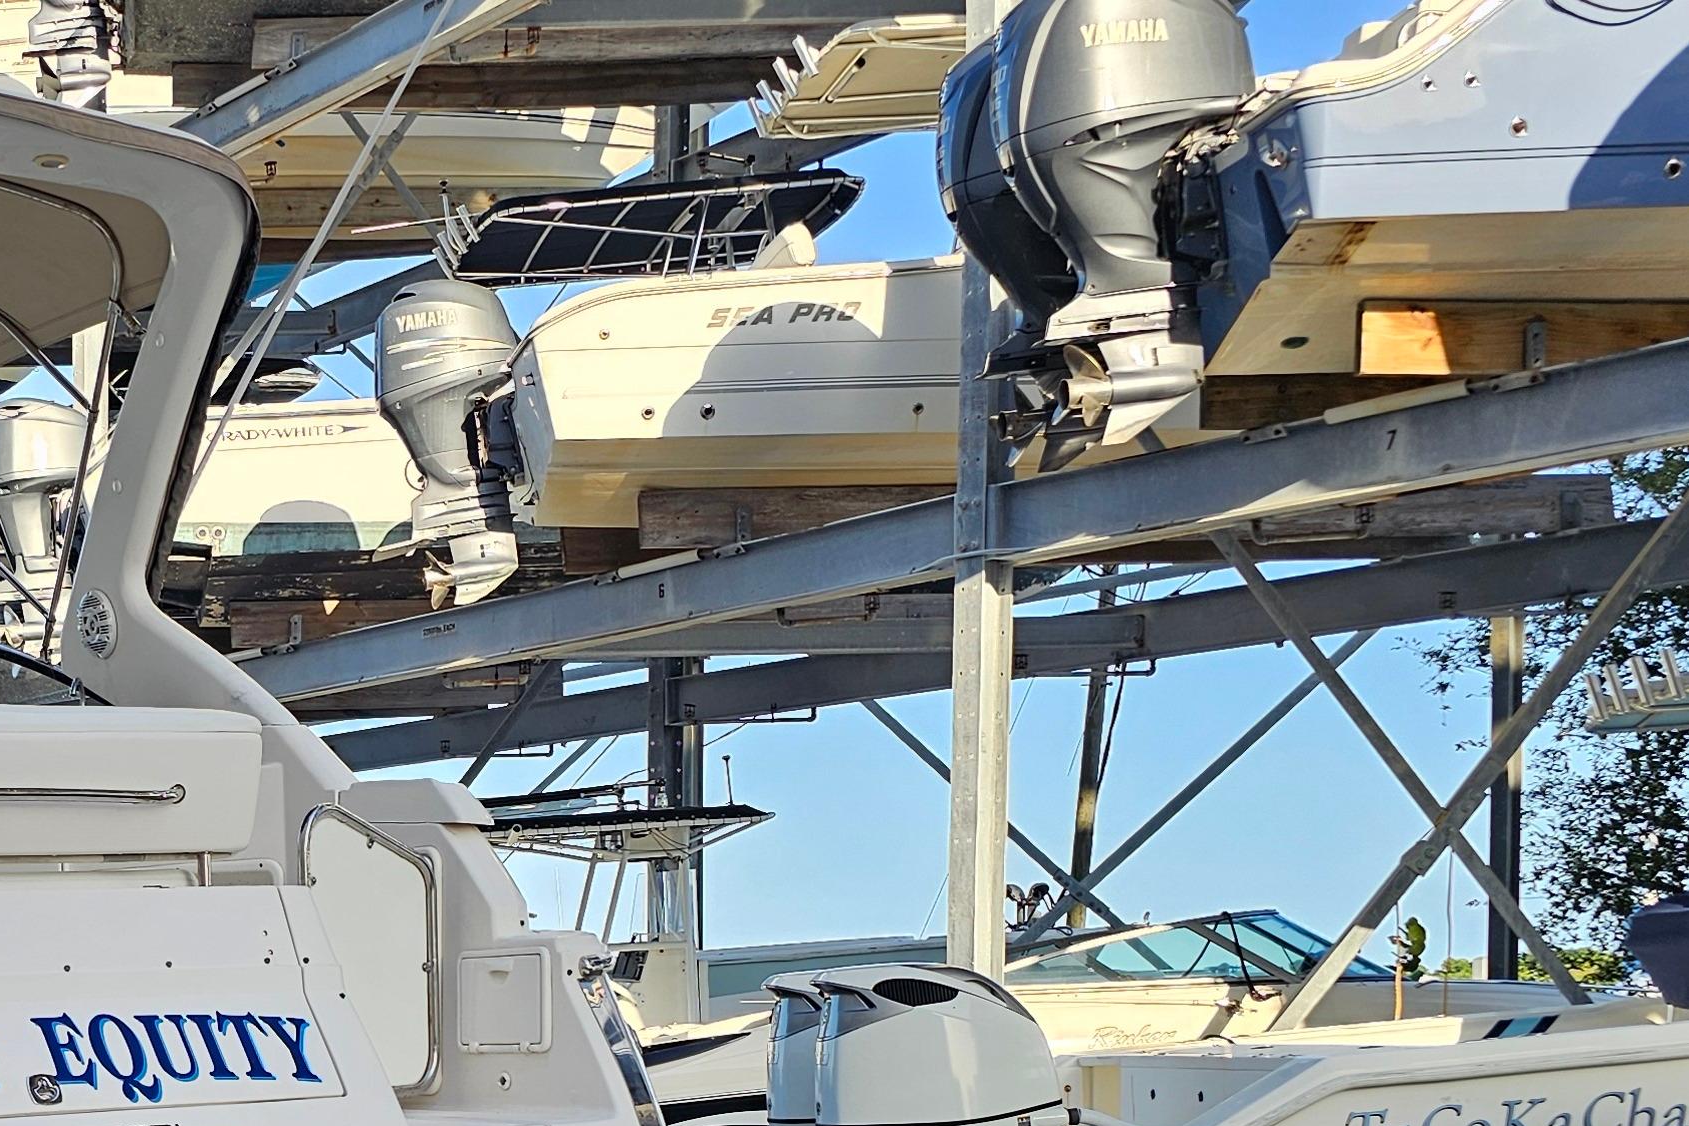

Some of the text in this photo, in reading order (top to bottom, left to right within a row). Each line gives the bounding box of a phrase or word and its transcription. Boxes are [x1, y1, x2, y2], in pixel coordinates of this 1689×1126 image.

[1079, 17, 1169, 48] YAMAHA
[395, 310, 458, 334] YAMAHA
[706, 302, 862, 328] SEA PRO
[1386, 429, 1398, 451] 7
[658, 583, 665, 599] 6
[30, 1012, 322, 1104] EQUITY
